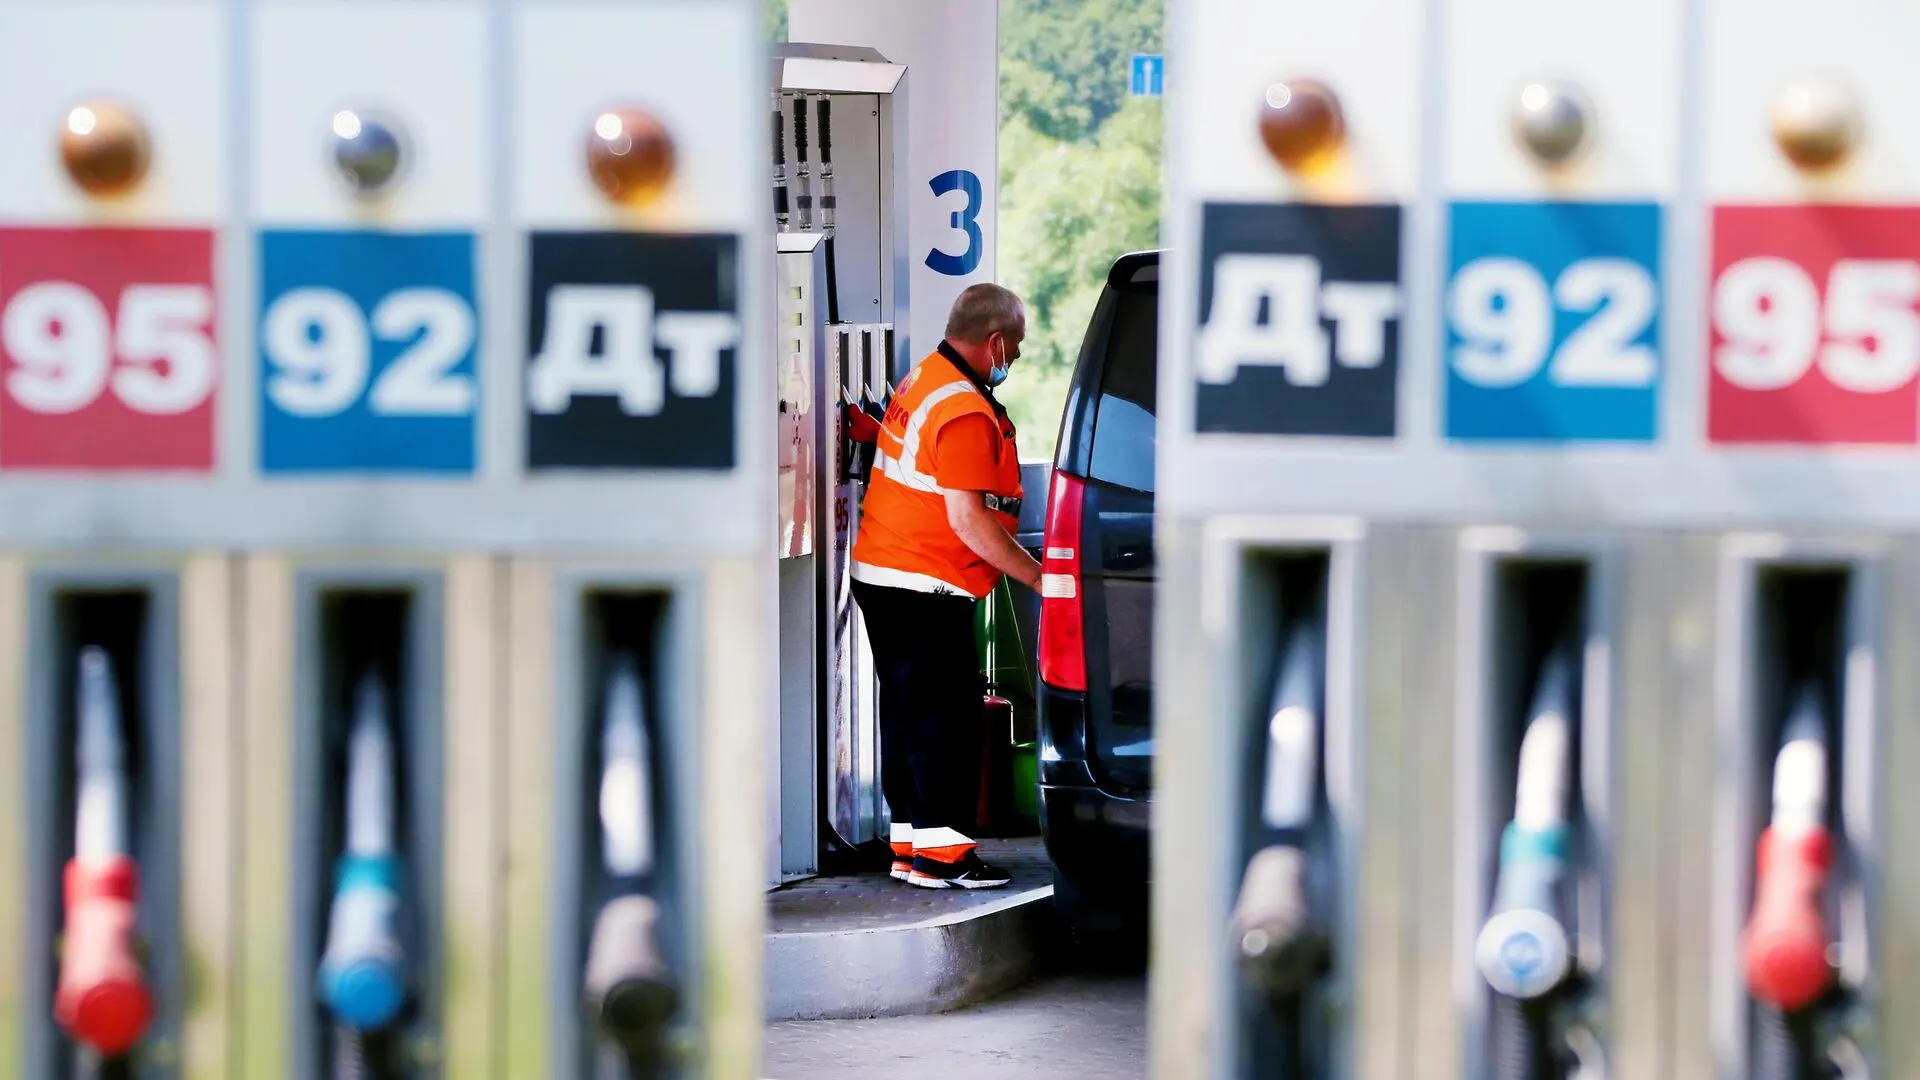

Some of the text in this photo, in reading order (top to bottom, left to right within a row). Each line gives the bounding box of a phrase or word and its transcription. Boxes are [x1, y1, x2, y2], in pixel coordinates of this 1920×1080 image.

[925, 169, 984, 276] 3
[2, 281, 216, 414] 95
[263, 287, 476, 416] 92
[530, 285, 739, 415] Дт
[1197, 254, 1402, 386] Дт
[1448, 257, 1658, 388] 92
[1712, 256, 1920, 393] 95
[836, 497, 849, 532] 95
